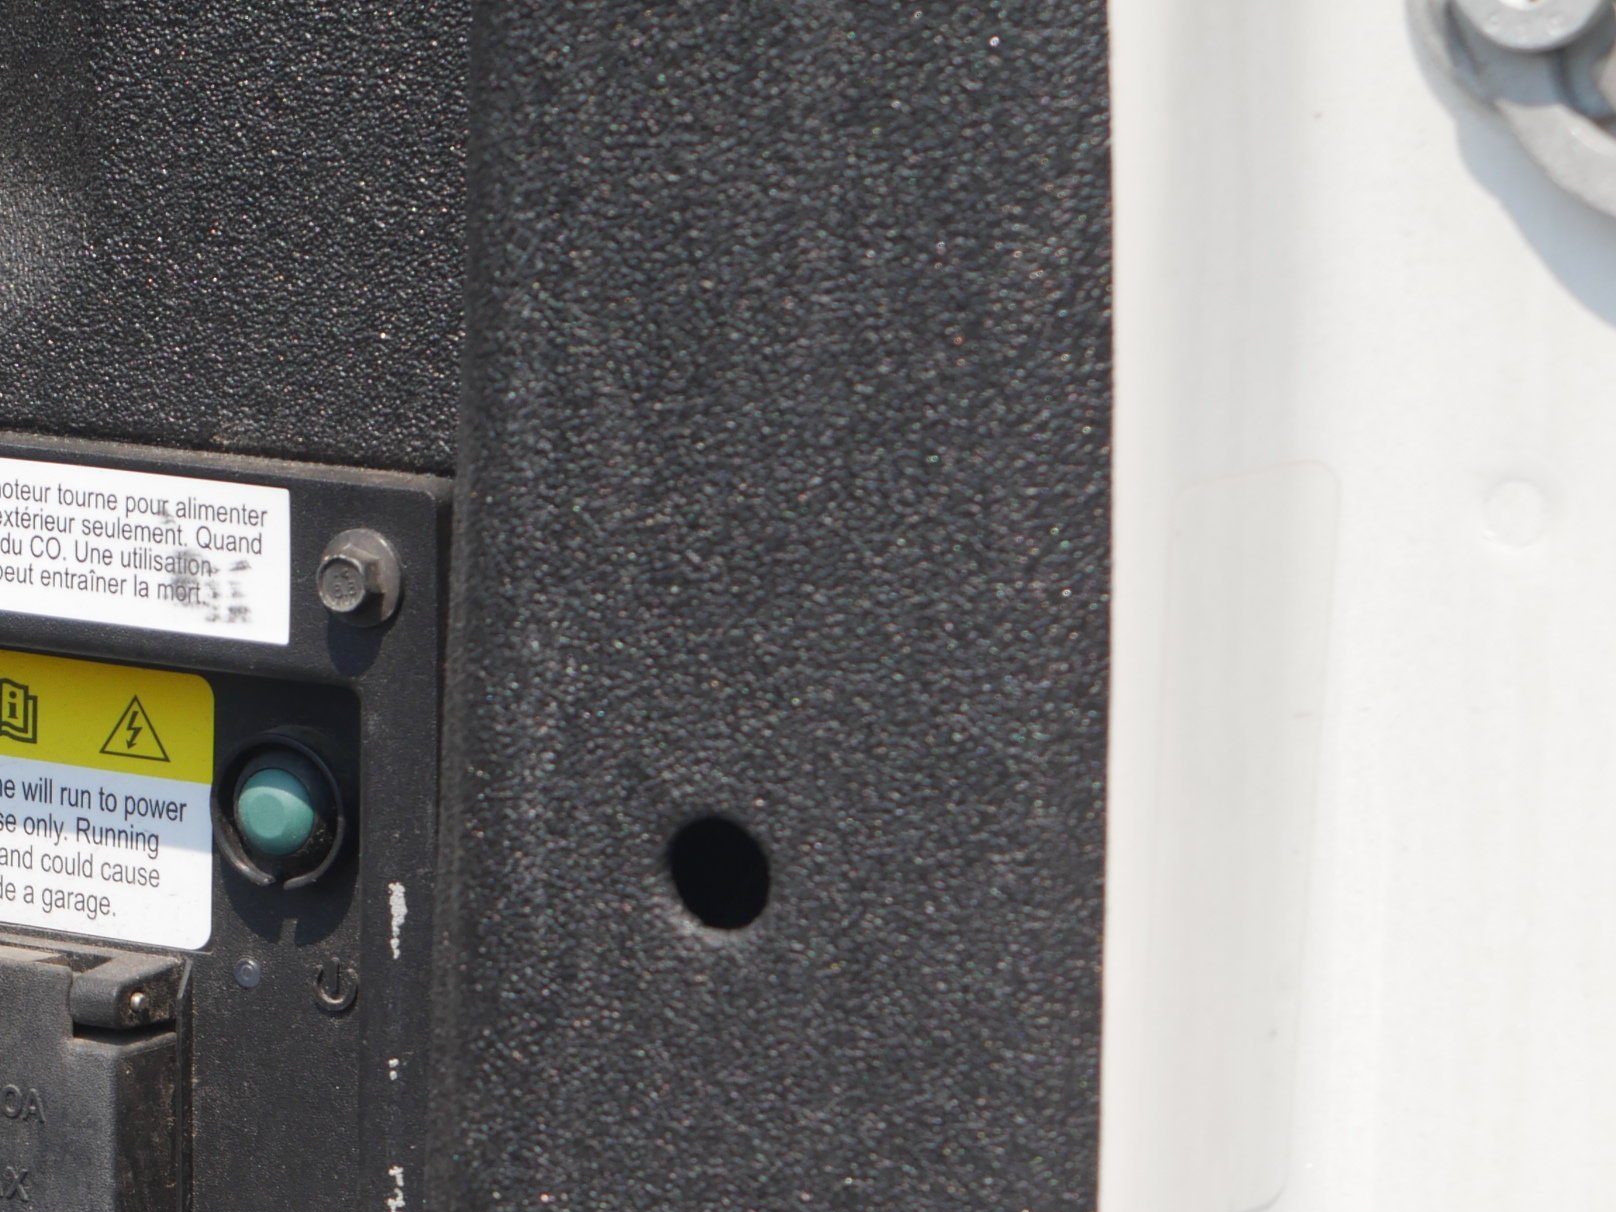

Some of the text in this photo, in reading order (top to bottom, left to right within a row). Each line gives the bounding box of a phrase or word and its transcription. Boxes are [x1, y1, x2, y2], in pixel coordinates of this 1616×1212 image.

[58, 483, 117, 510] tourne
[126, 495, 169, 518] pour
[176, 497, 267, 526] alimenter
[0, 533, 22, 555] du
[30, 534, 67, 561] CO.
[75, 540, 113, 566] Une
[121, 547, 212, 577] utilisation
[82, 517, 187, 546] seulement.
[196, 525, 262, 554] Quand
[40, 565, 126, 595] entraîner
[134, 575, 149, 598] la
[158, 584, 206, 605] mort.
[22, 778, 52, 805] will
[60, 787, 91, 809] run
[98, 787, 117, 812] to
[124, 794, 187, 822] power
[24, 814, 67, 846] only.
[77, 817, 159, 859] Running
[41, 850, 93, 878] could
[100, 863, 160, 887] cause
[24, 884, 34, 904] a
[42, 890, 116, 921] garage.
